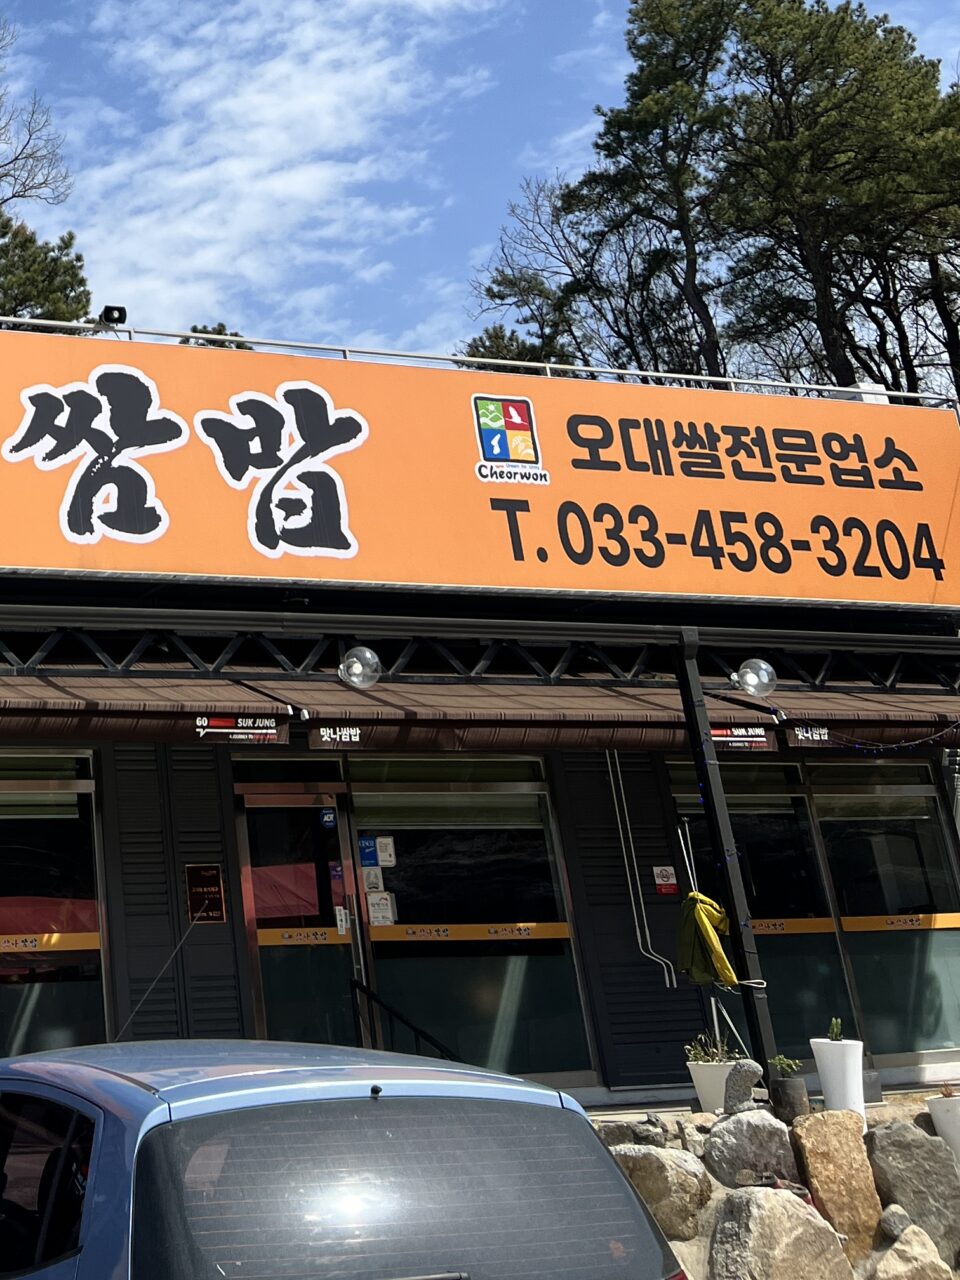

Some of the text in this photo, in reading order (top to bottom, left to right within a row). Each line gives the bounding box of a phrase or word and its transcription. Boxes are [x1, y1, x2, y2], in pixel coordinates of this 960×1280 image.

[566, 413, 924, 491] 오대쌀전문업소
[478, 464, 548, 482] Cheorwon
[196, 717, 208, 726] GO
[254, 718, 276, 727] JUNG
[320, 727, 361, 742] 맛나쌈밥
